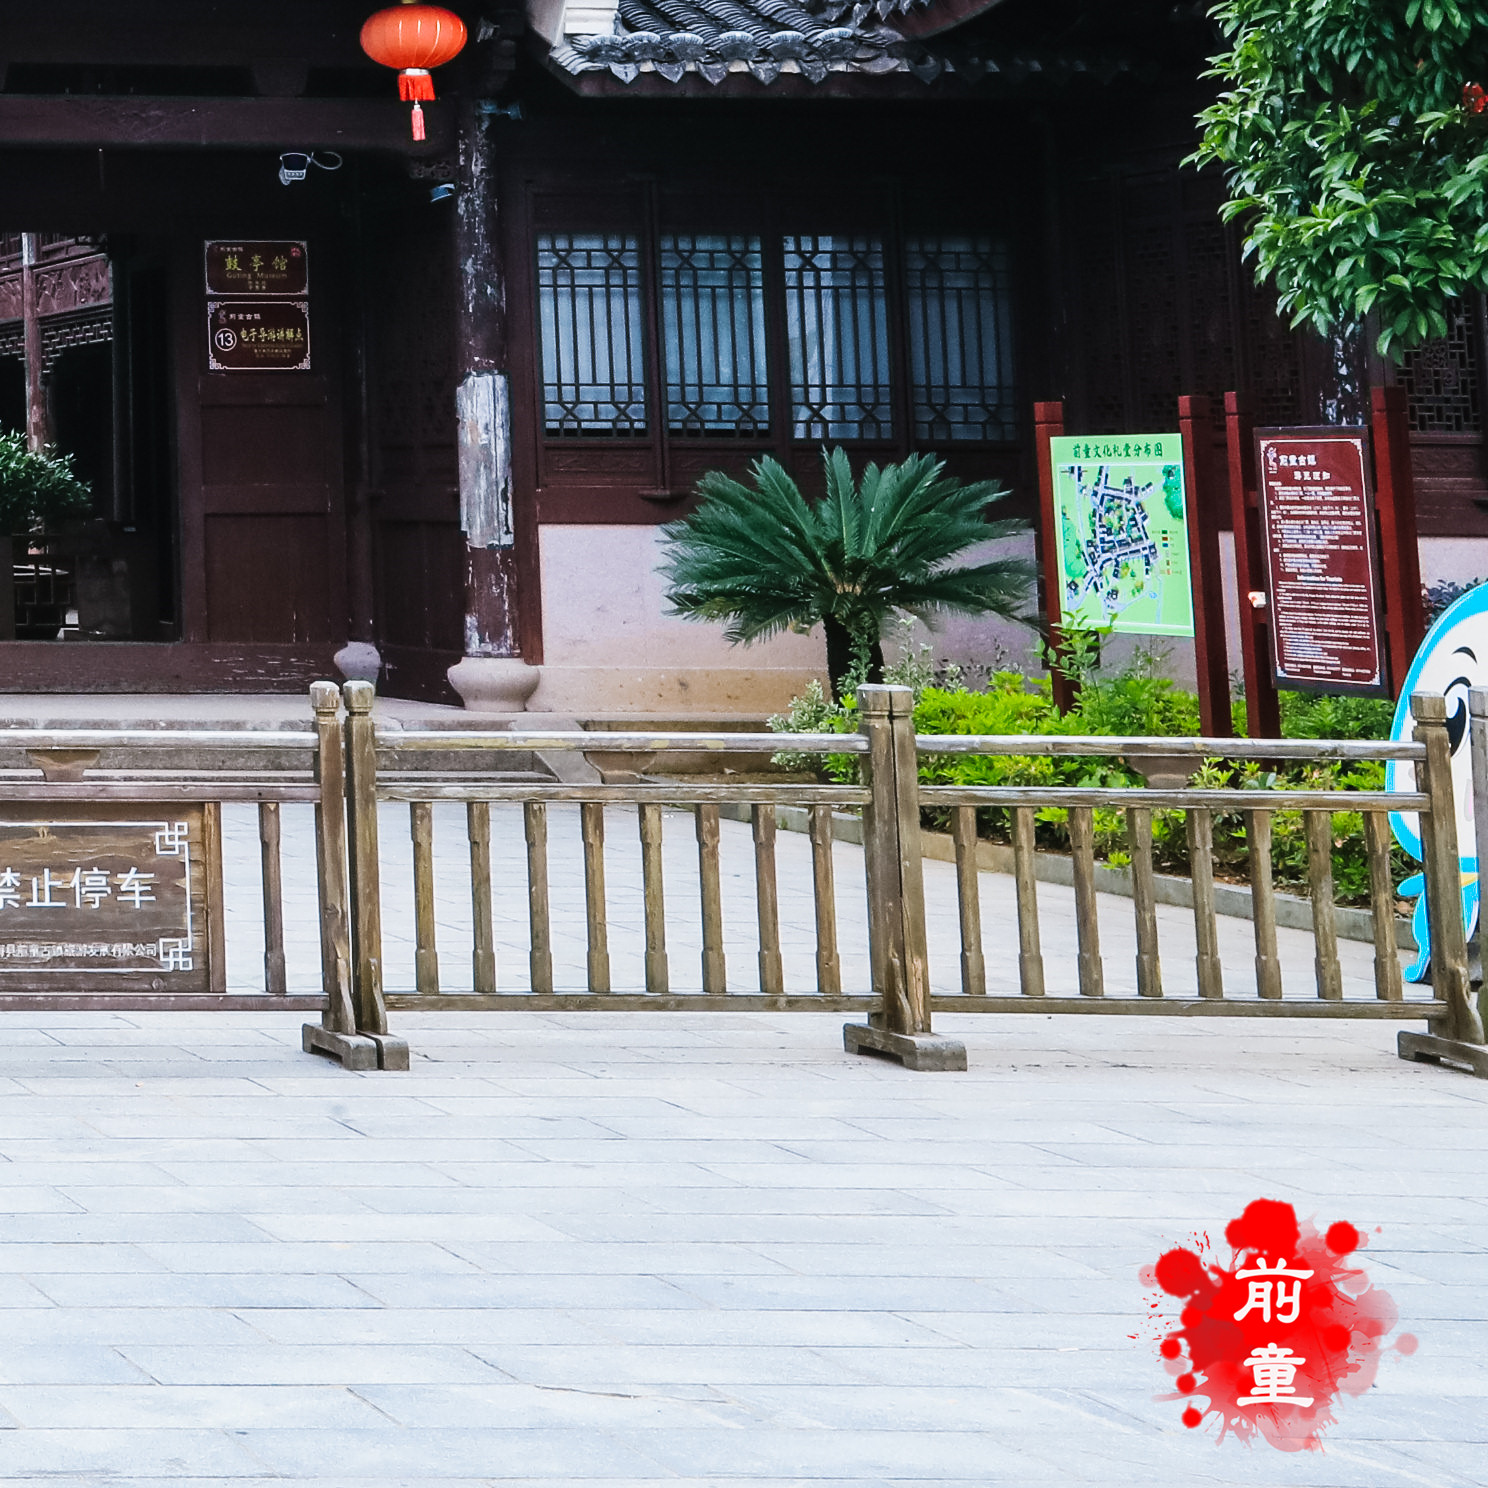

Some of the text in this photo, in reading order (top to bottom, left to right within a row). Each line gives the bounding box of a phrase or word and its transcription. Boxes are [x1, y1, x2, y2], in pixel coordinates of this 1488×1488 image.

[224, 253, 289, 272] 鼓亭馆
[217, 332, 234, 347] 13
